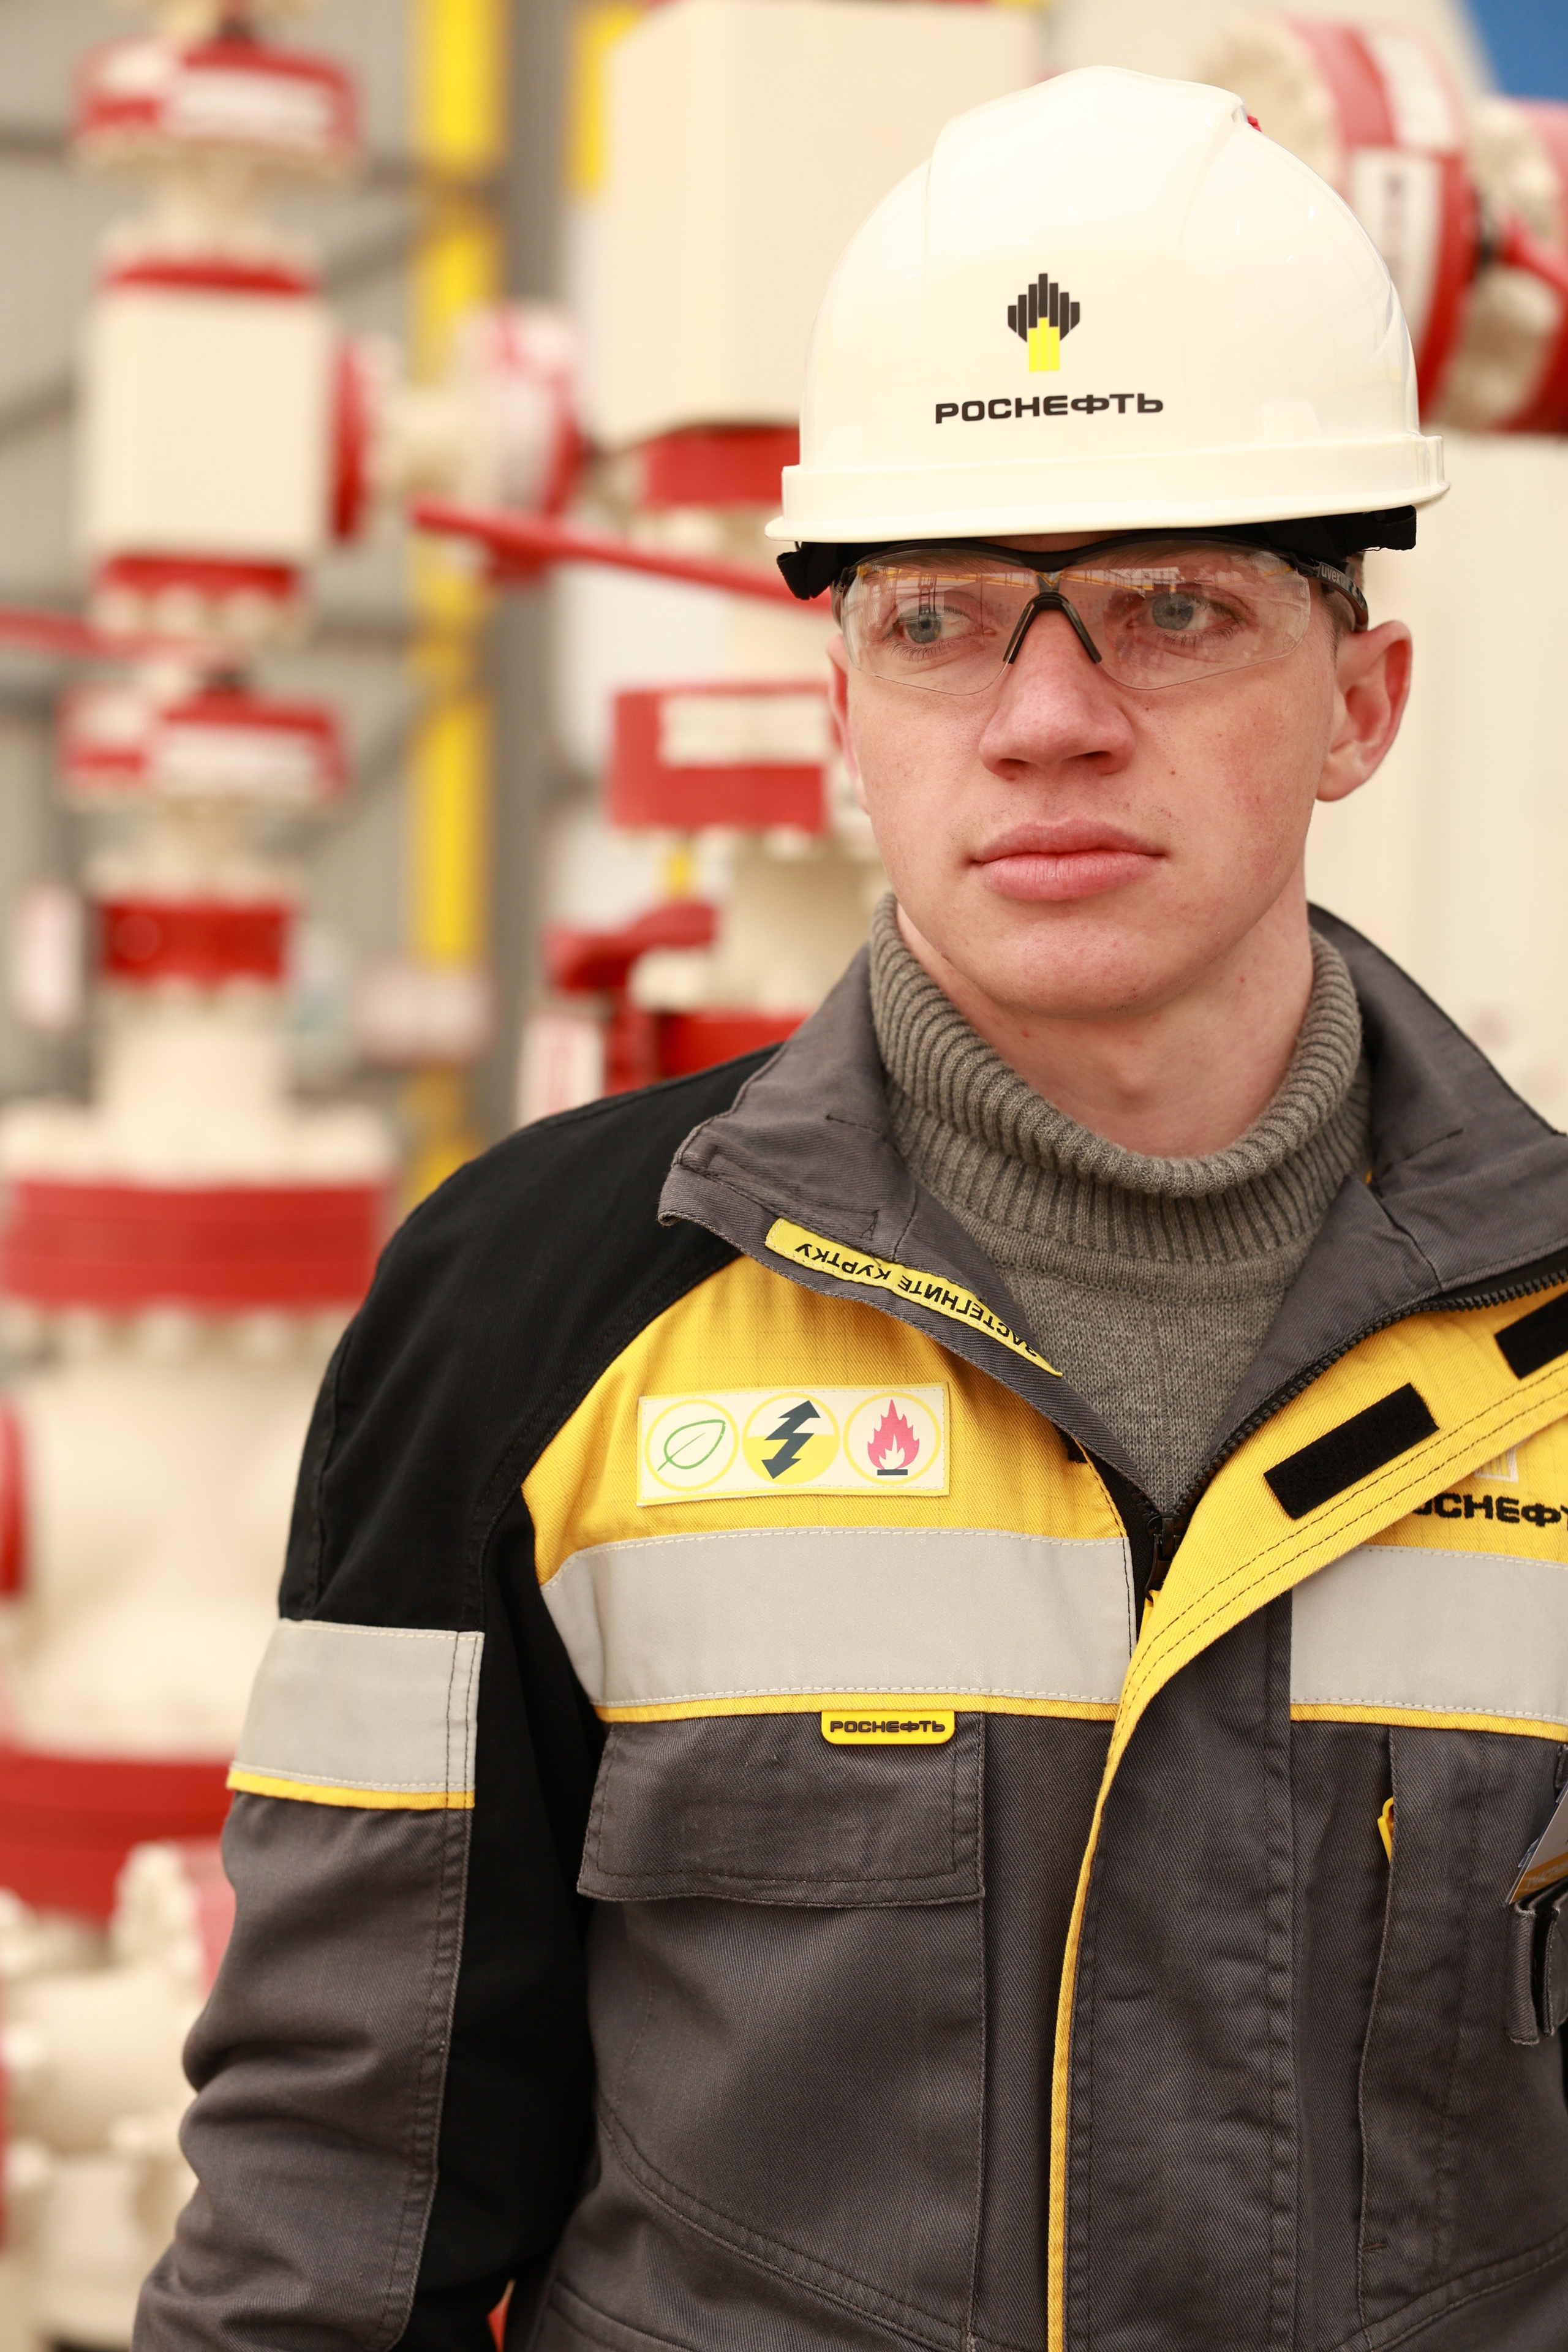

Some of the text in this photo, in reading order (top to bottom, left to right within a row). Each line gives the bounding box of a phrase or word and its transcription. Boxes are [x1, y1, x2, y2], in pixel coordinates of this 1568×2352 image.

[935, 393, 1163, 424] РОСНЕФТЬ
[1321, 565, 1341, 585] uvex
[794, 1243, 892, 1280] КУРТКУ
[830, 1720, 946, 1733] РОСНЕФТЬ
